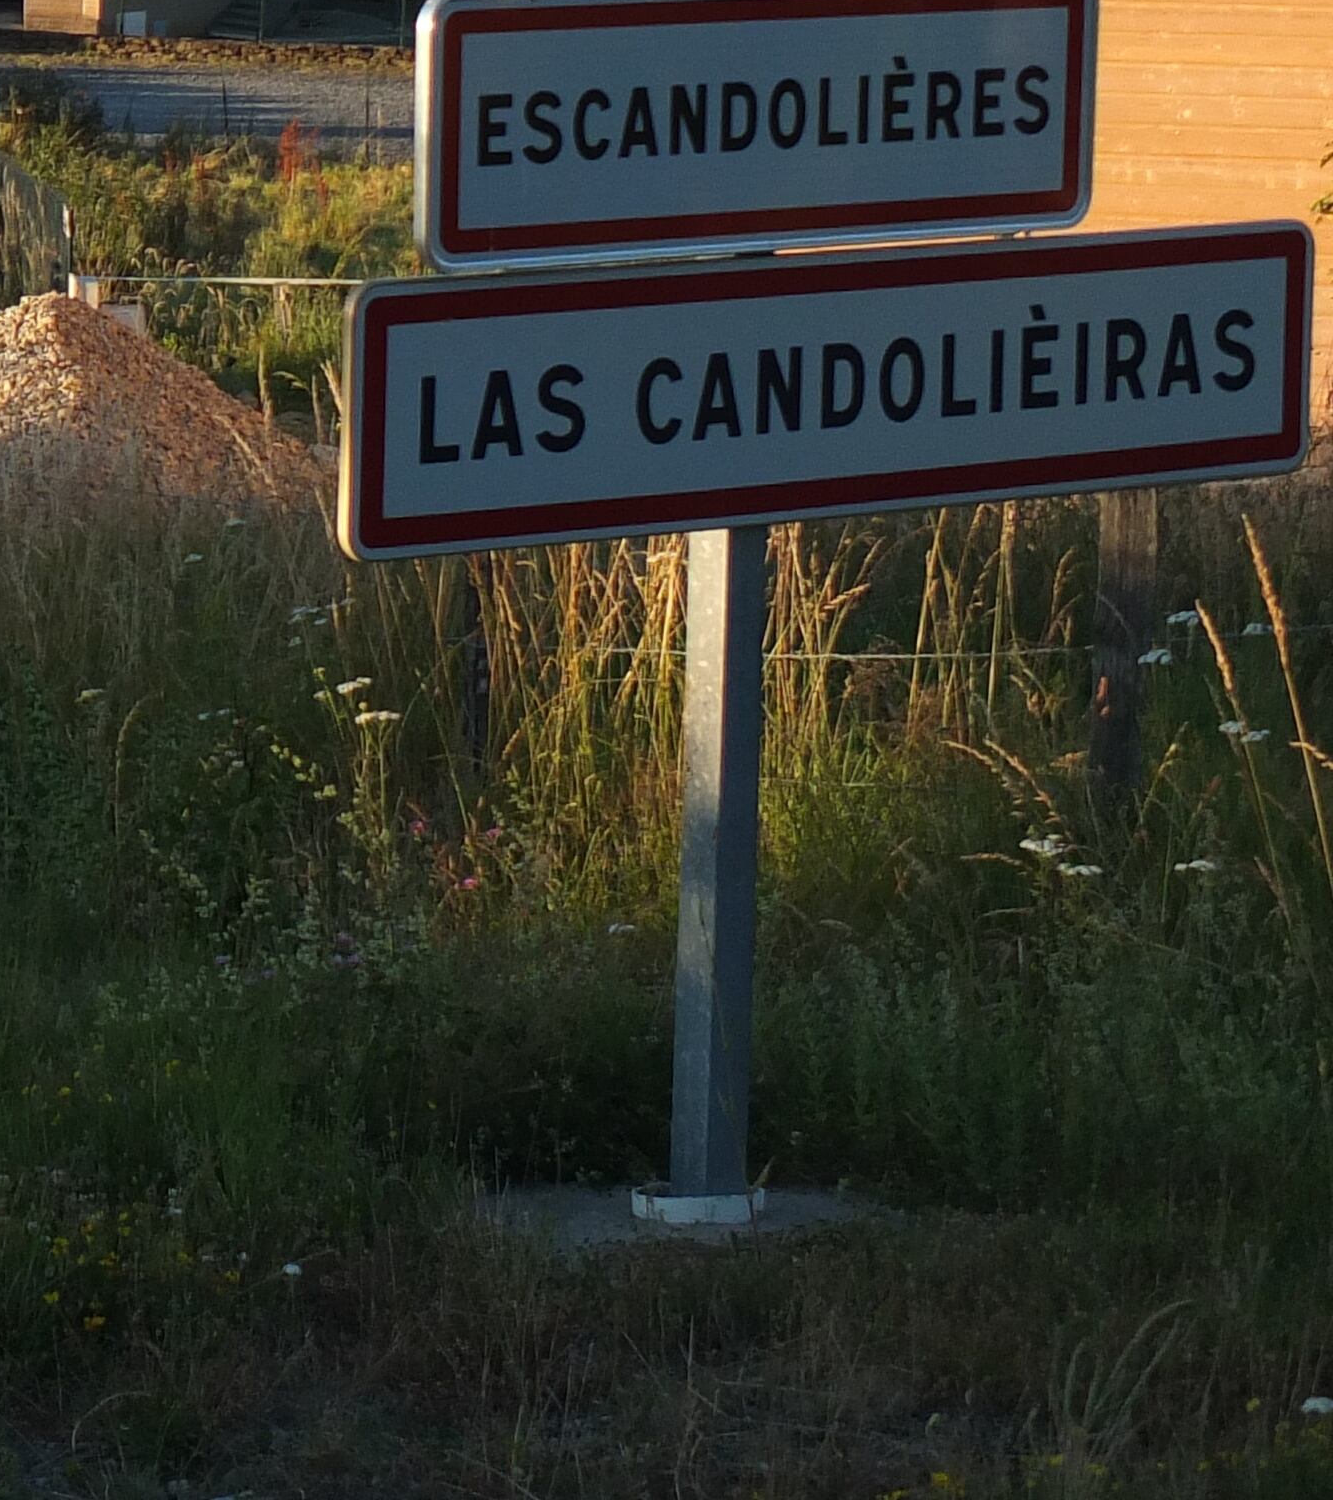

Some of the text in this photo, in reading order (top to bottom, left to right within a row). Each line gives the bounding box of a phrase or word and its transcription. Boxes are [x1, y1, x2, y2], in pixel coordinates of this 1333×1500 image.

[475, 56, 1050, 167] ESCANDOLIÈRES
[419, 303, 1257, 465] LAS CANDOLIÈIRAS
